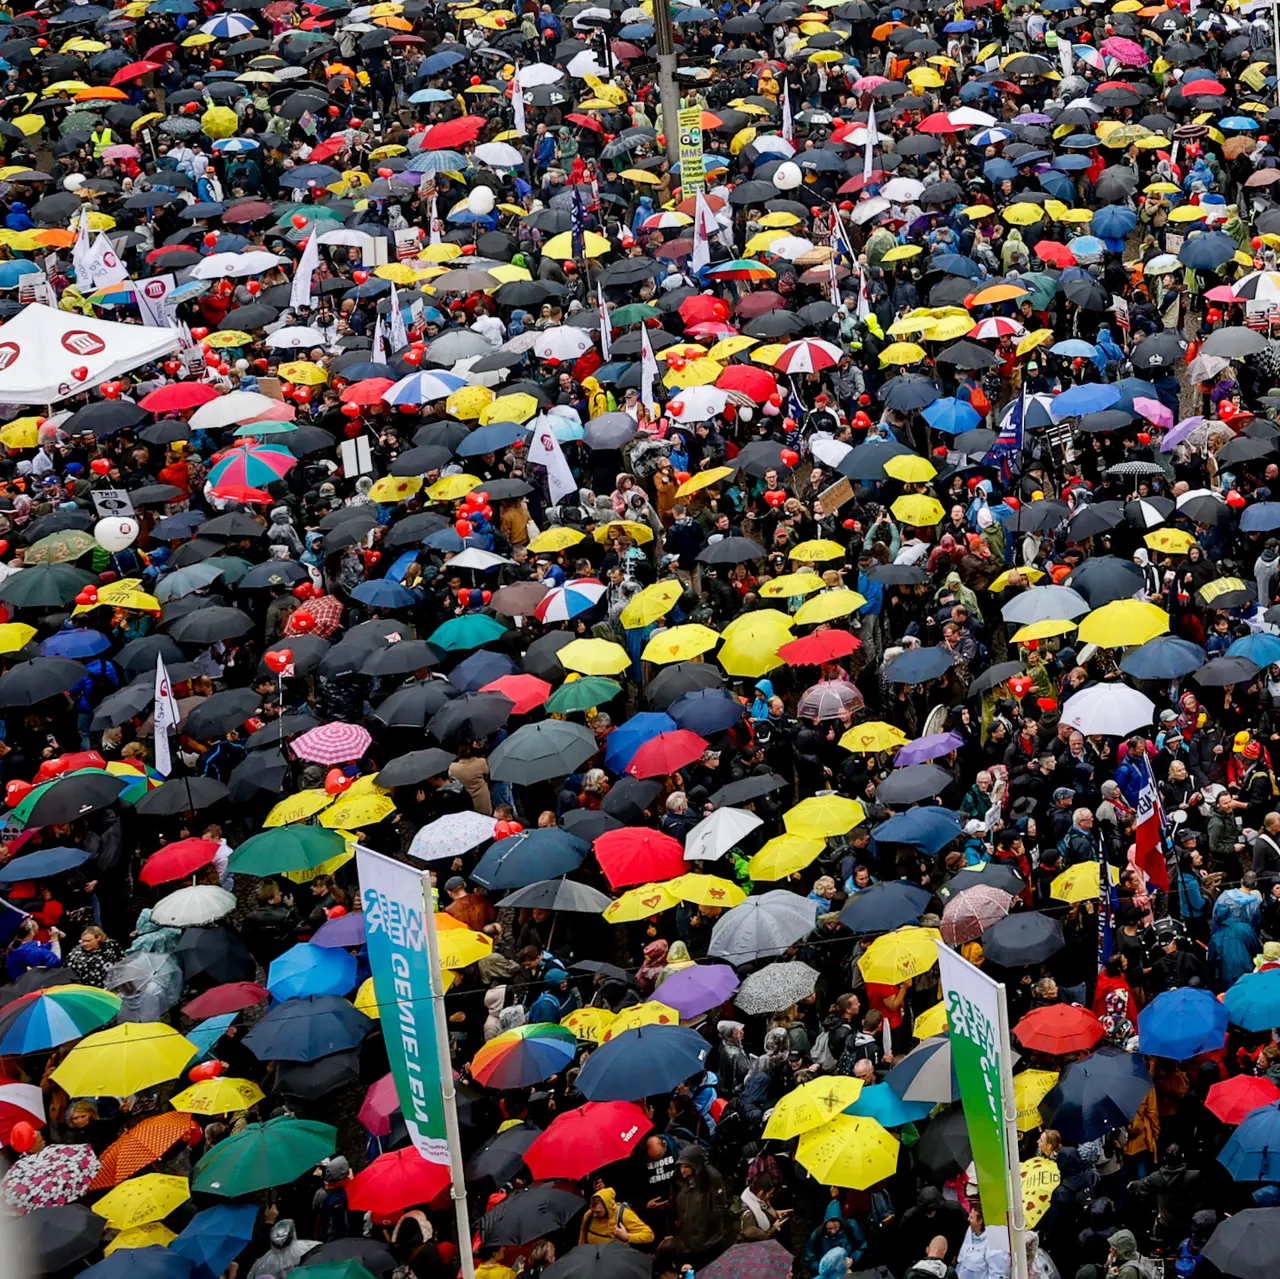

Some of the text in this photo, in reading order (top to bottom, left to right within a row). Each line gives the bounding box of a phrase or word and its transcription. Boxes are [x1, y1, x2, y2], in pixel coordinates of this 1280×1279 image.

[681, 148, 702, 159] MMS
[283, 806, 305, 824] LOVE
[301, 865, 325, 880] LOVE
[187, 1098, 211, 1111] SMILE
[655, 1167, 664, 1175] IS
